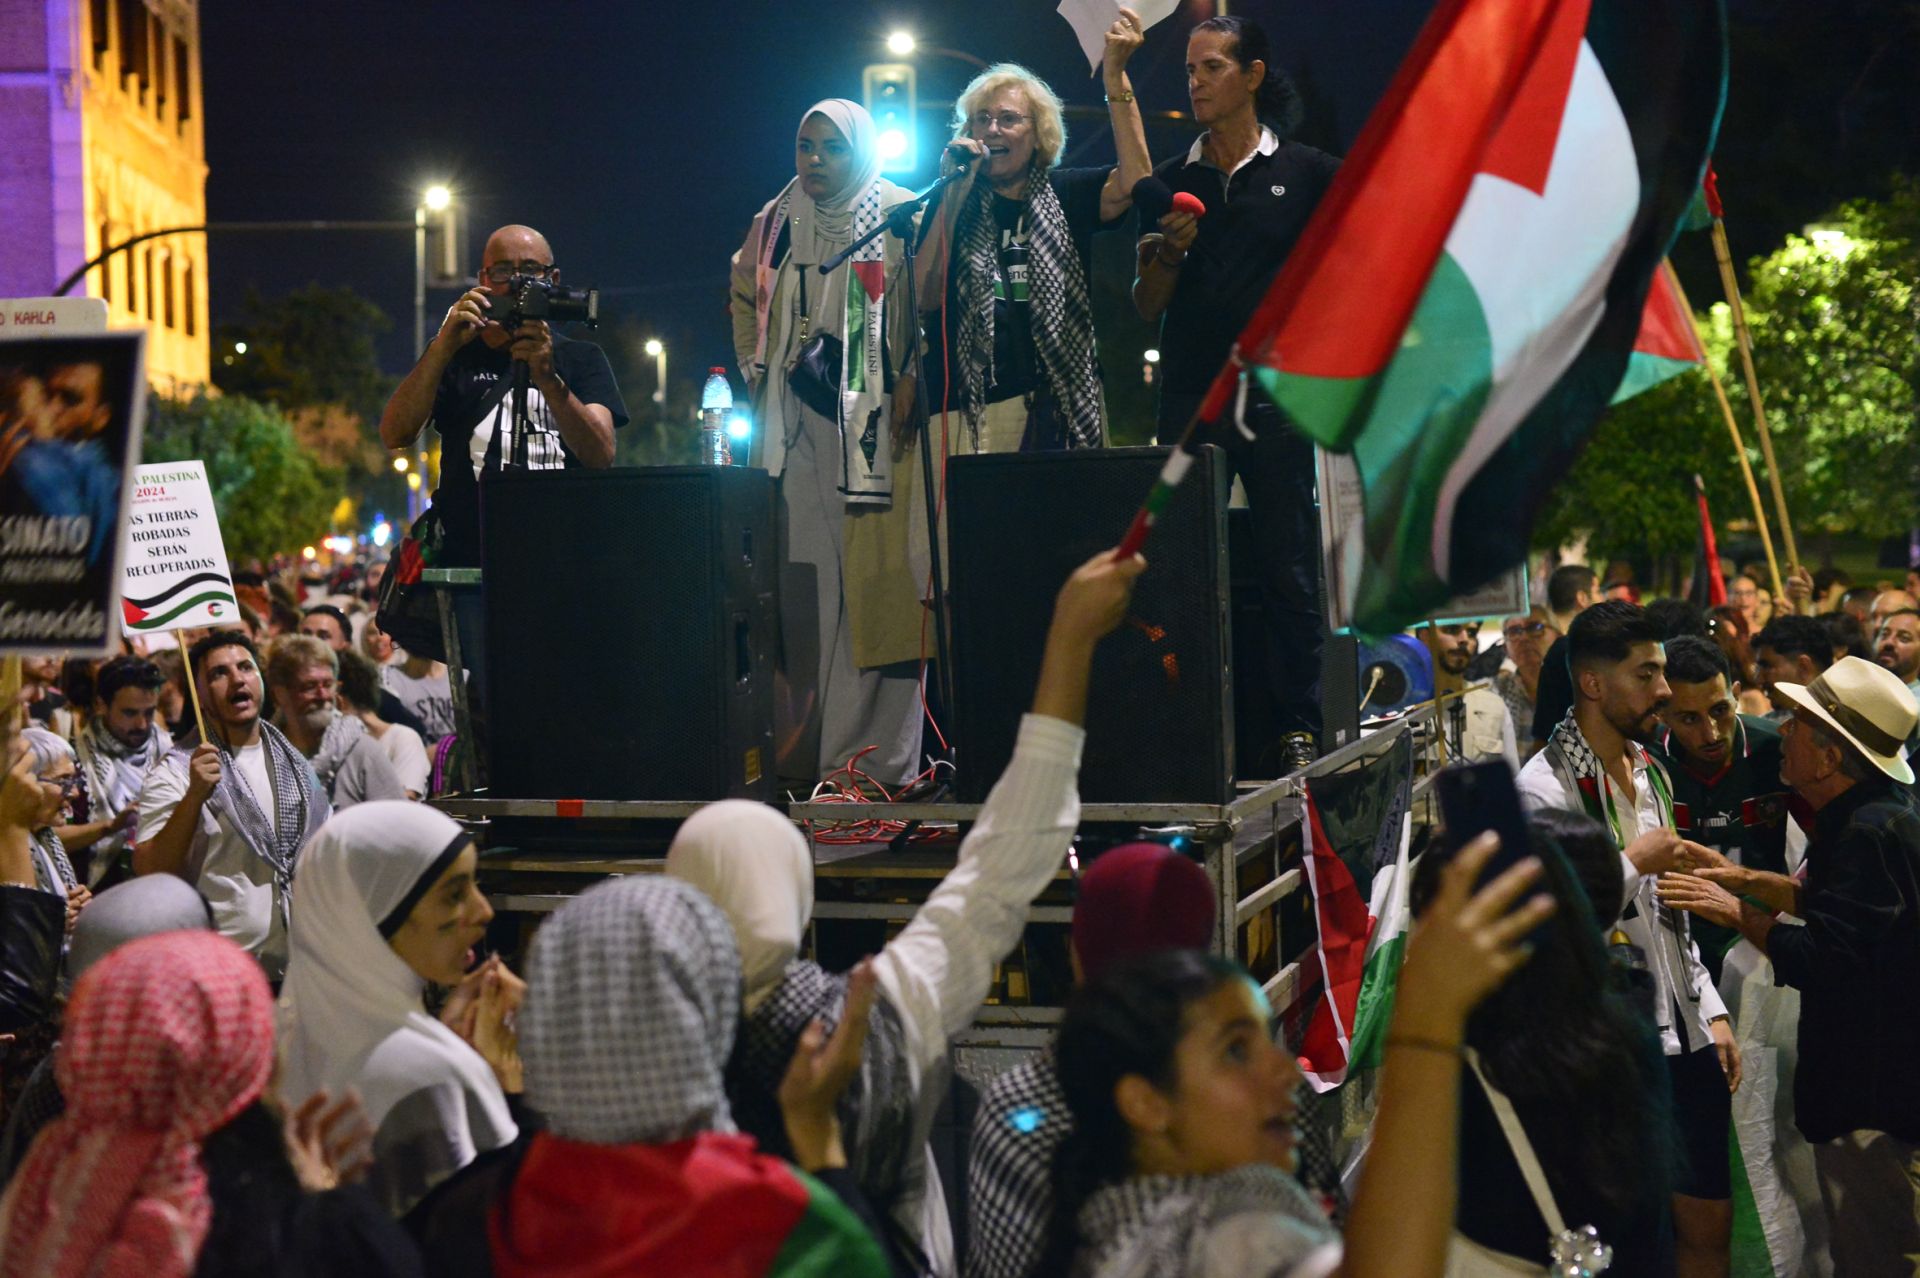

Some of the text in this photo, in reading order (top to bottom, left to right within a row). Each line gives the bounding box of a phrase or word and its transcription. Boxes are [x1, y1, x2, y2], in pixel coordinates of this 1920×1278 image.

[868, 311, 878, 376] PALESTINE
[142, 471, 200, 485] PALESTINA
[136, 486, 165, 498] 2024
[148, 509, 199, 523] TIERRAS
[132, 527, 191, 542] ROBADAS
[147, 542, 187, 557] SERÁN
[126, 557, 216, 577] RECUPERADAS
